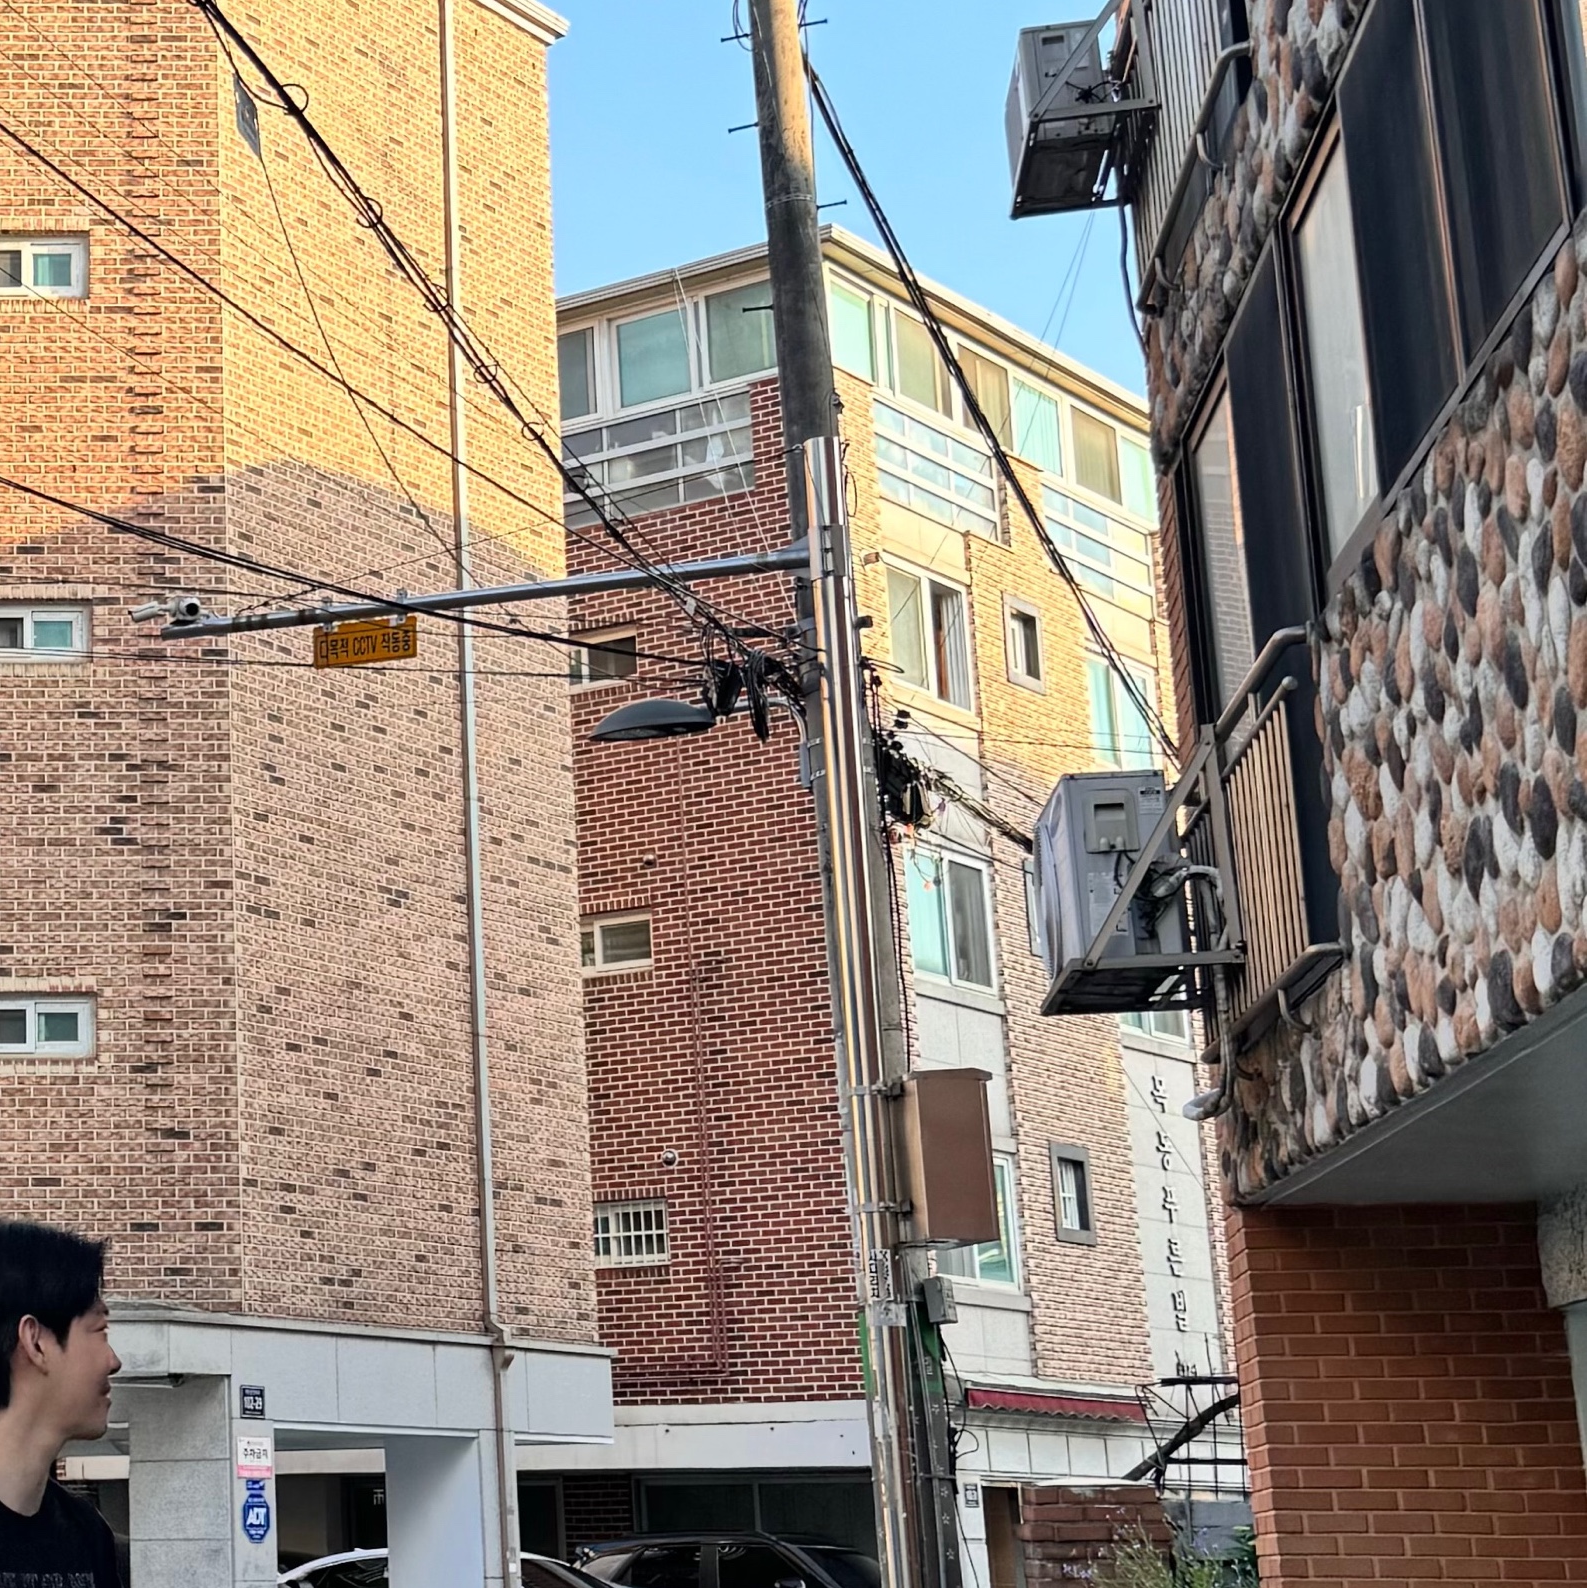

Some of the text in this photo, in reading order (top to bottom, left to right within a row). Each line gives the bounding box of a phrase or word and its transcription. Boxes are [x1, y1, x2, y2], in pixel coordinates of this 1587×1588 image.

[353, 635, 377, 656] CCTV
[381, 629, 411, 652] 작동중
[243, 1448, 268, 1459] 주차금지
[246, 1507, 266, 1526] ADT
